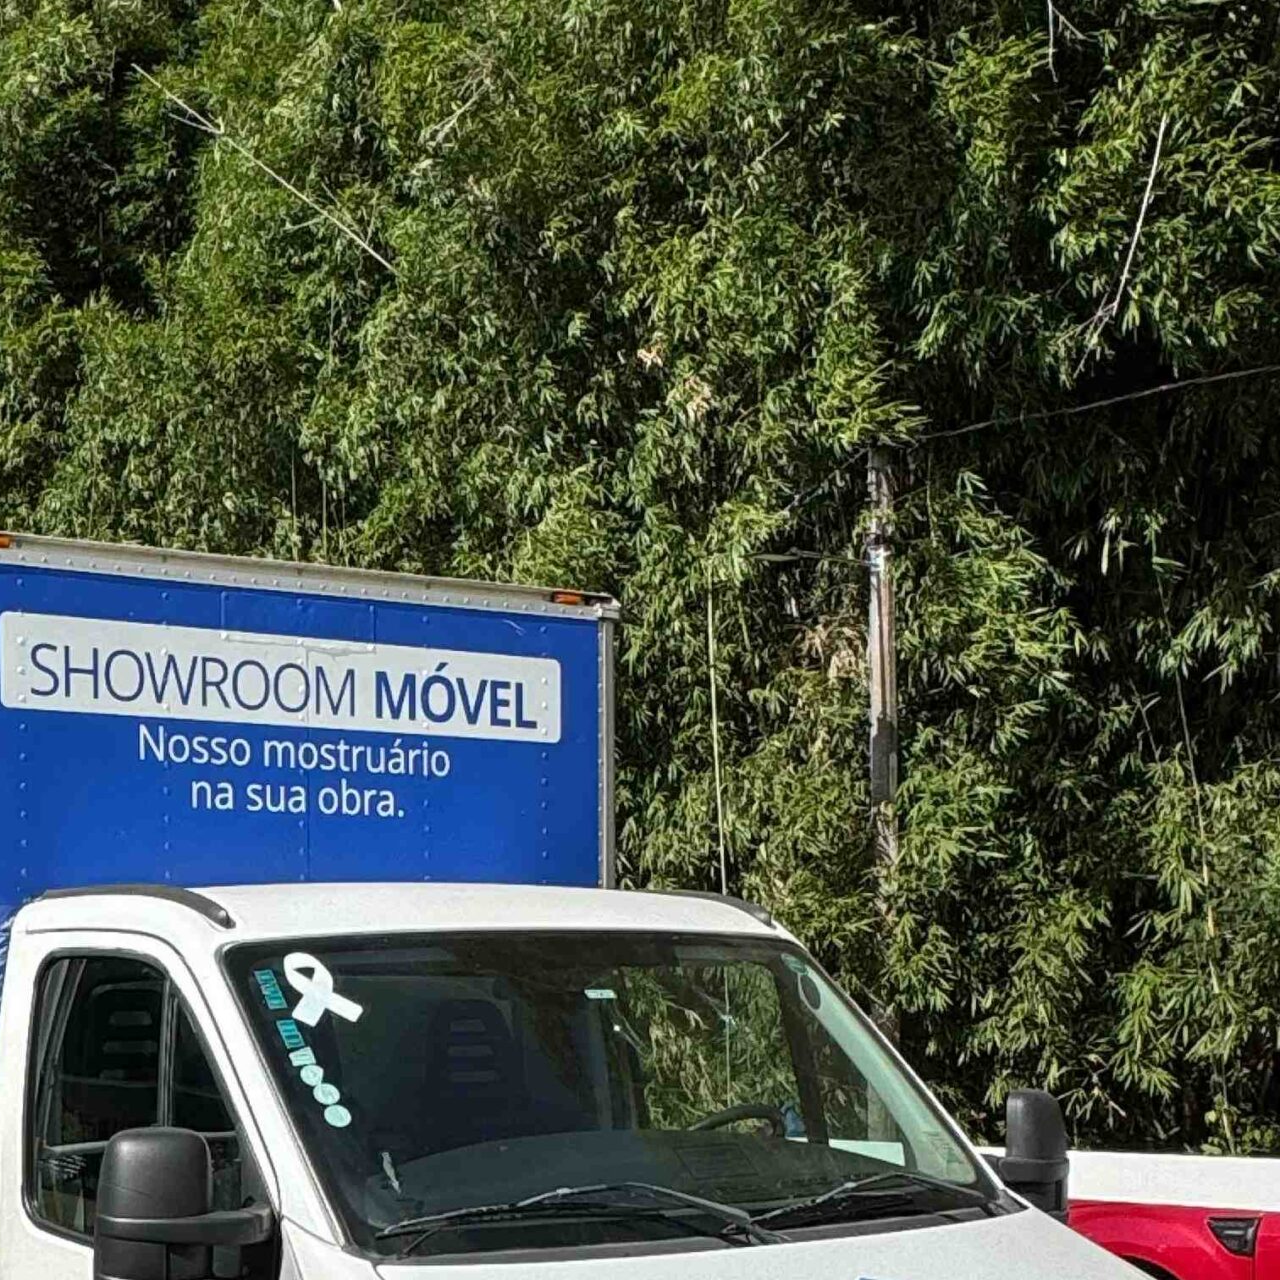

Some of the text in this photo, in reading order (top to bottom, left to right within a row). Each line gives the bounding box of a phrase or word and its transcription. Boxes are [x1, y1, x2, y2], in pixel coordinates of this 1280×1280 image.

[30, 643, 538, 730] SHOWROOM MÓVEL
[138, 724, 450, 778] Nosso mostruário
[191, 777, 405, 818] na sua obra.
